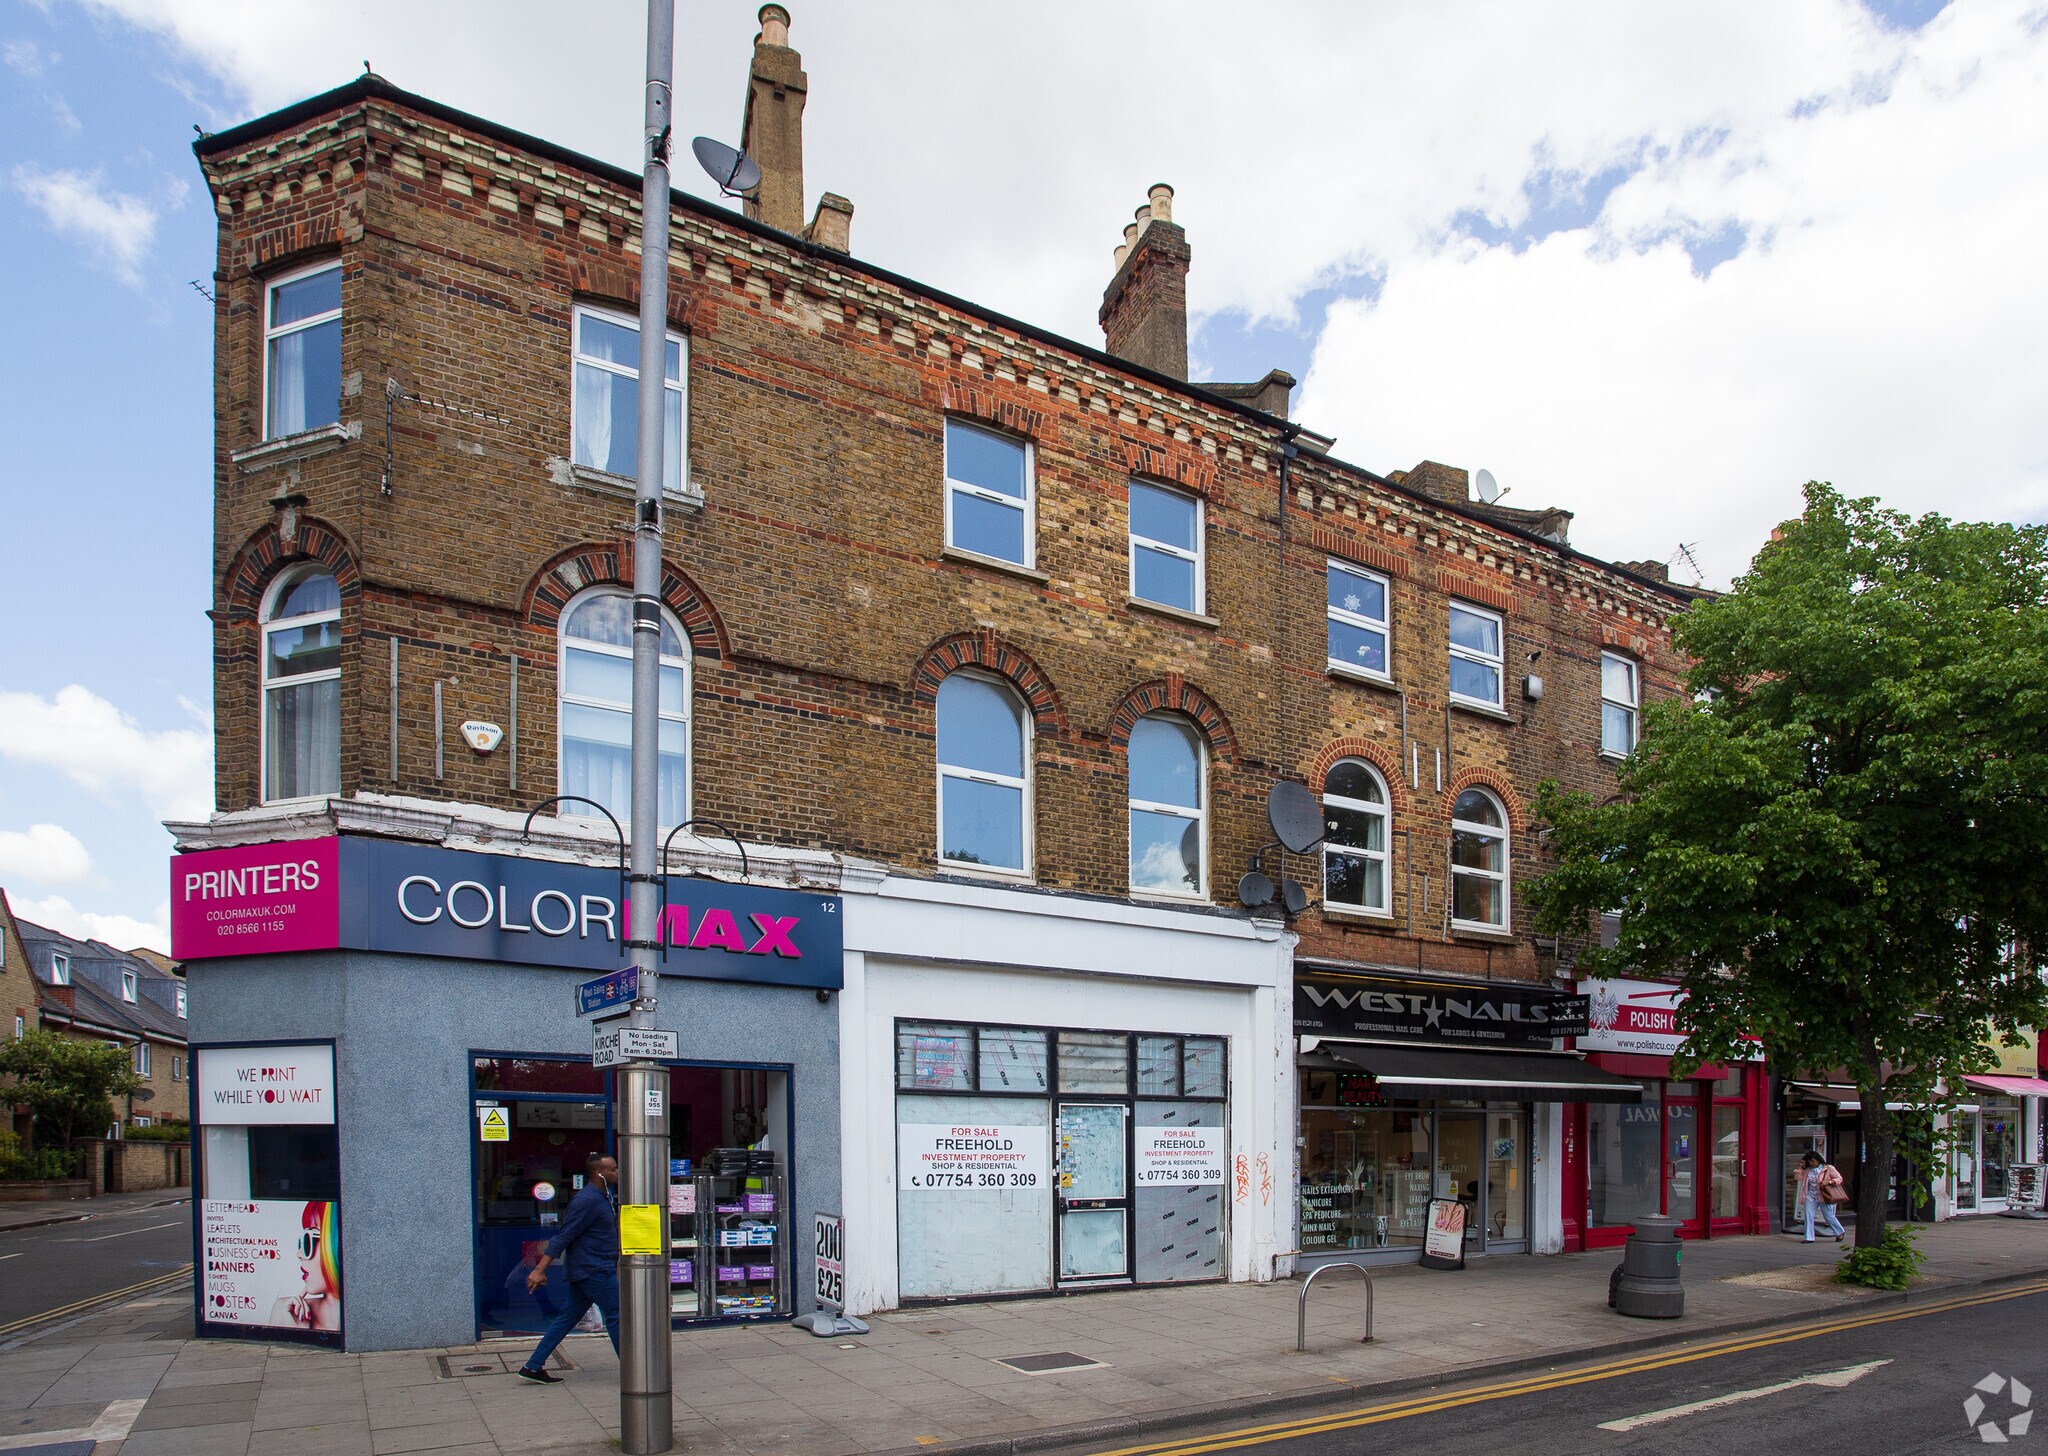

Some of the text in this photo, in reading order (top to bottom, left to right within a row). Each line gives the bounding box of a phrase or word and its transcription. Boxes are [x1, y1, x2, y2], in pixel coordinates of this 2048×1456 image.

[185, 859, 319, 901] PRINTERS
[206, 904, 296, 921] COLORMAXUK.COM
[821, 902, 835, 913] 12
[217, 920, 284, 936] 020 8566 1155
[1301, 985, 1548, 1024] WEST NAILS
[1630, 1011, 1667, 1030] POLISH
[1354, 1022, 1394, 1032] PROFESSIONAL
[1441, 1028, 1452, 1036] FOR
[594, 1034, 618, 1050] KIRCHE
[642, 1032, 668, 1041] loading
[1617, 1040, 1681, 1050] www.polishcu.co.
[594, 1050, 614, 1065] ROAD
[237, 1066, 296, 1082] WE PRINT
[214, 1088, 322, 1104] WHILE YOU WAIT
[952, 1128, 998, 1136] FOR SALE
[936, 1138, 1014, 1150] FREEHOLD
[1154, 1140, 1206, 1148] FREEHOLD
[926, 1173, 1037, 1186] 07754 360 309
[1148, 1169, 1220, 1180] 07754 360 309
[1302, 1184, 1354, 1195] NAILS EXTENSIONS
[206, 1202, 260, 1214] LETTERHEADS
[1302, 1198, 1332, 1208] MANICURE
[1302, 1210, 1341, 1220] SPA PEDICURE
[207, 1224, 241, 1234] LEAFLETS
[1302, 1222, 1336, 1232] MINX NAILS
[208, 1237, 256, 1245] ARCHITECTURAL
[816, 1220, 842, 1262] 200
[1302, 1235, 1337, 1245] COLOUR GEL
[208, 1247, 281, 1260] BUSINESS CARDS
[208, 1261, 254, 1273] BANNERS
[208, 1282, 235, 1292] MUGS
[818, 1267, 842, 1302] £25
[210, 1294, 256, 1310] POSTERS
[210, 1311, 238, 1320] CANVAS
